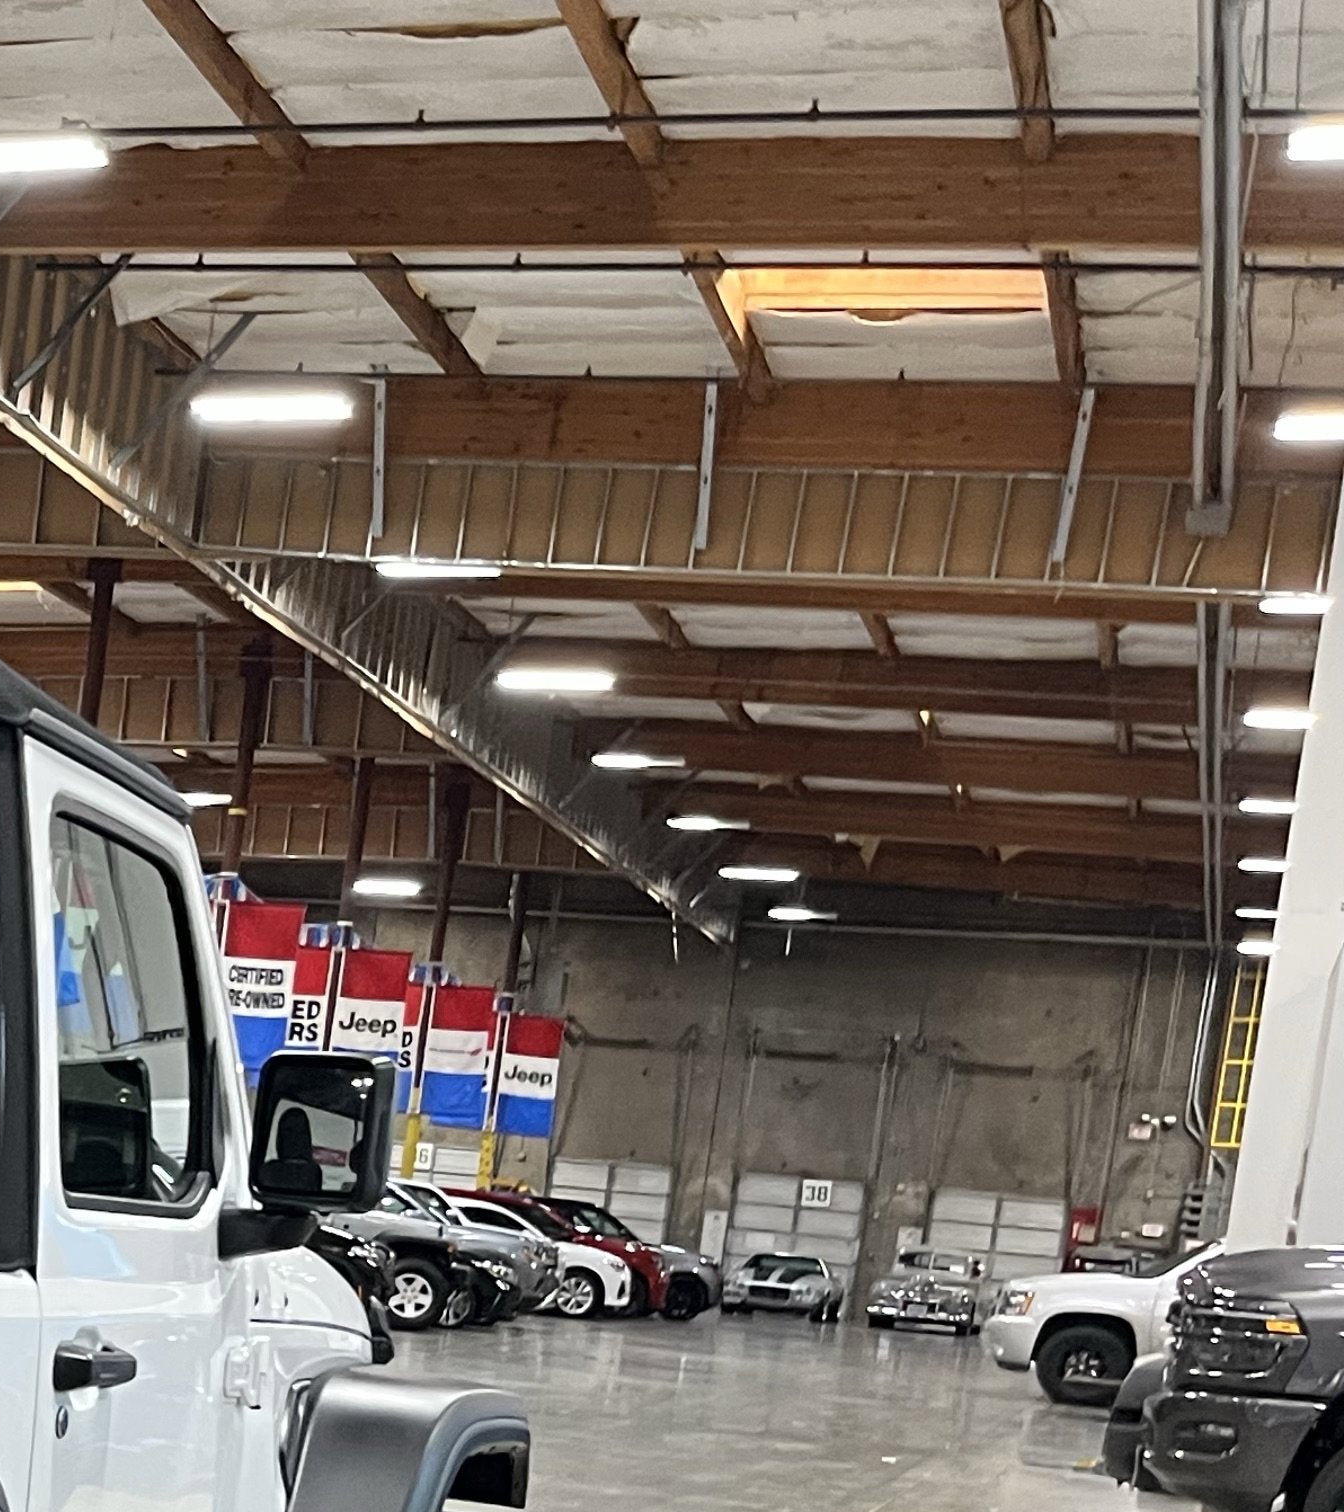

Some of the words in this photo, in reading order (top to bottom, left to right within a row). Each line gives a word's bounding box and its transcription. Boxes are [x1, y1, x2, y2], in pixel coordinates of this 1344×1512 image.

[228, 988, 285, 1009] RE-OWNED
[292, 999, 321, 1020] ED
[288, 1022, 318, 1043] RS
[338, 1011, 397, 1038] Jeep
[504, 1064, 553, 1088] Jeep
[418, 1148, 429, 1164] 6
[804, 1185, 829, 1202] 38
